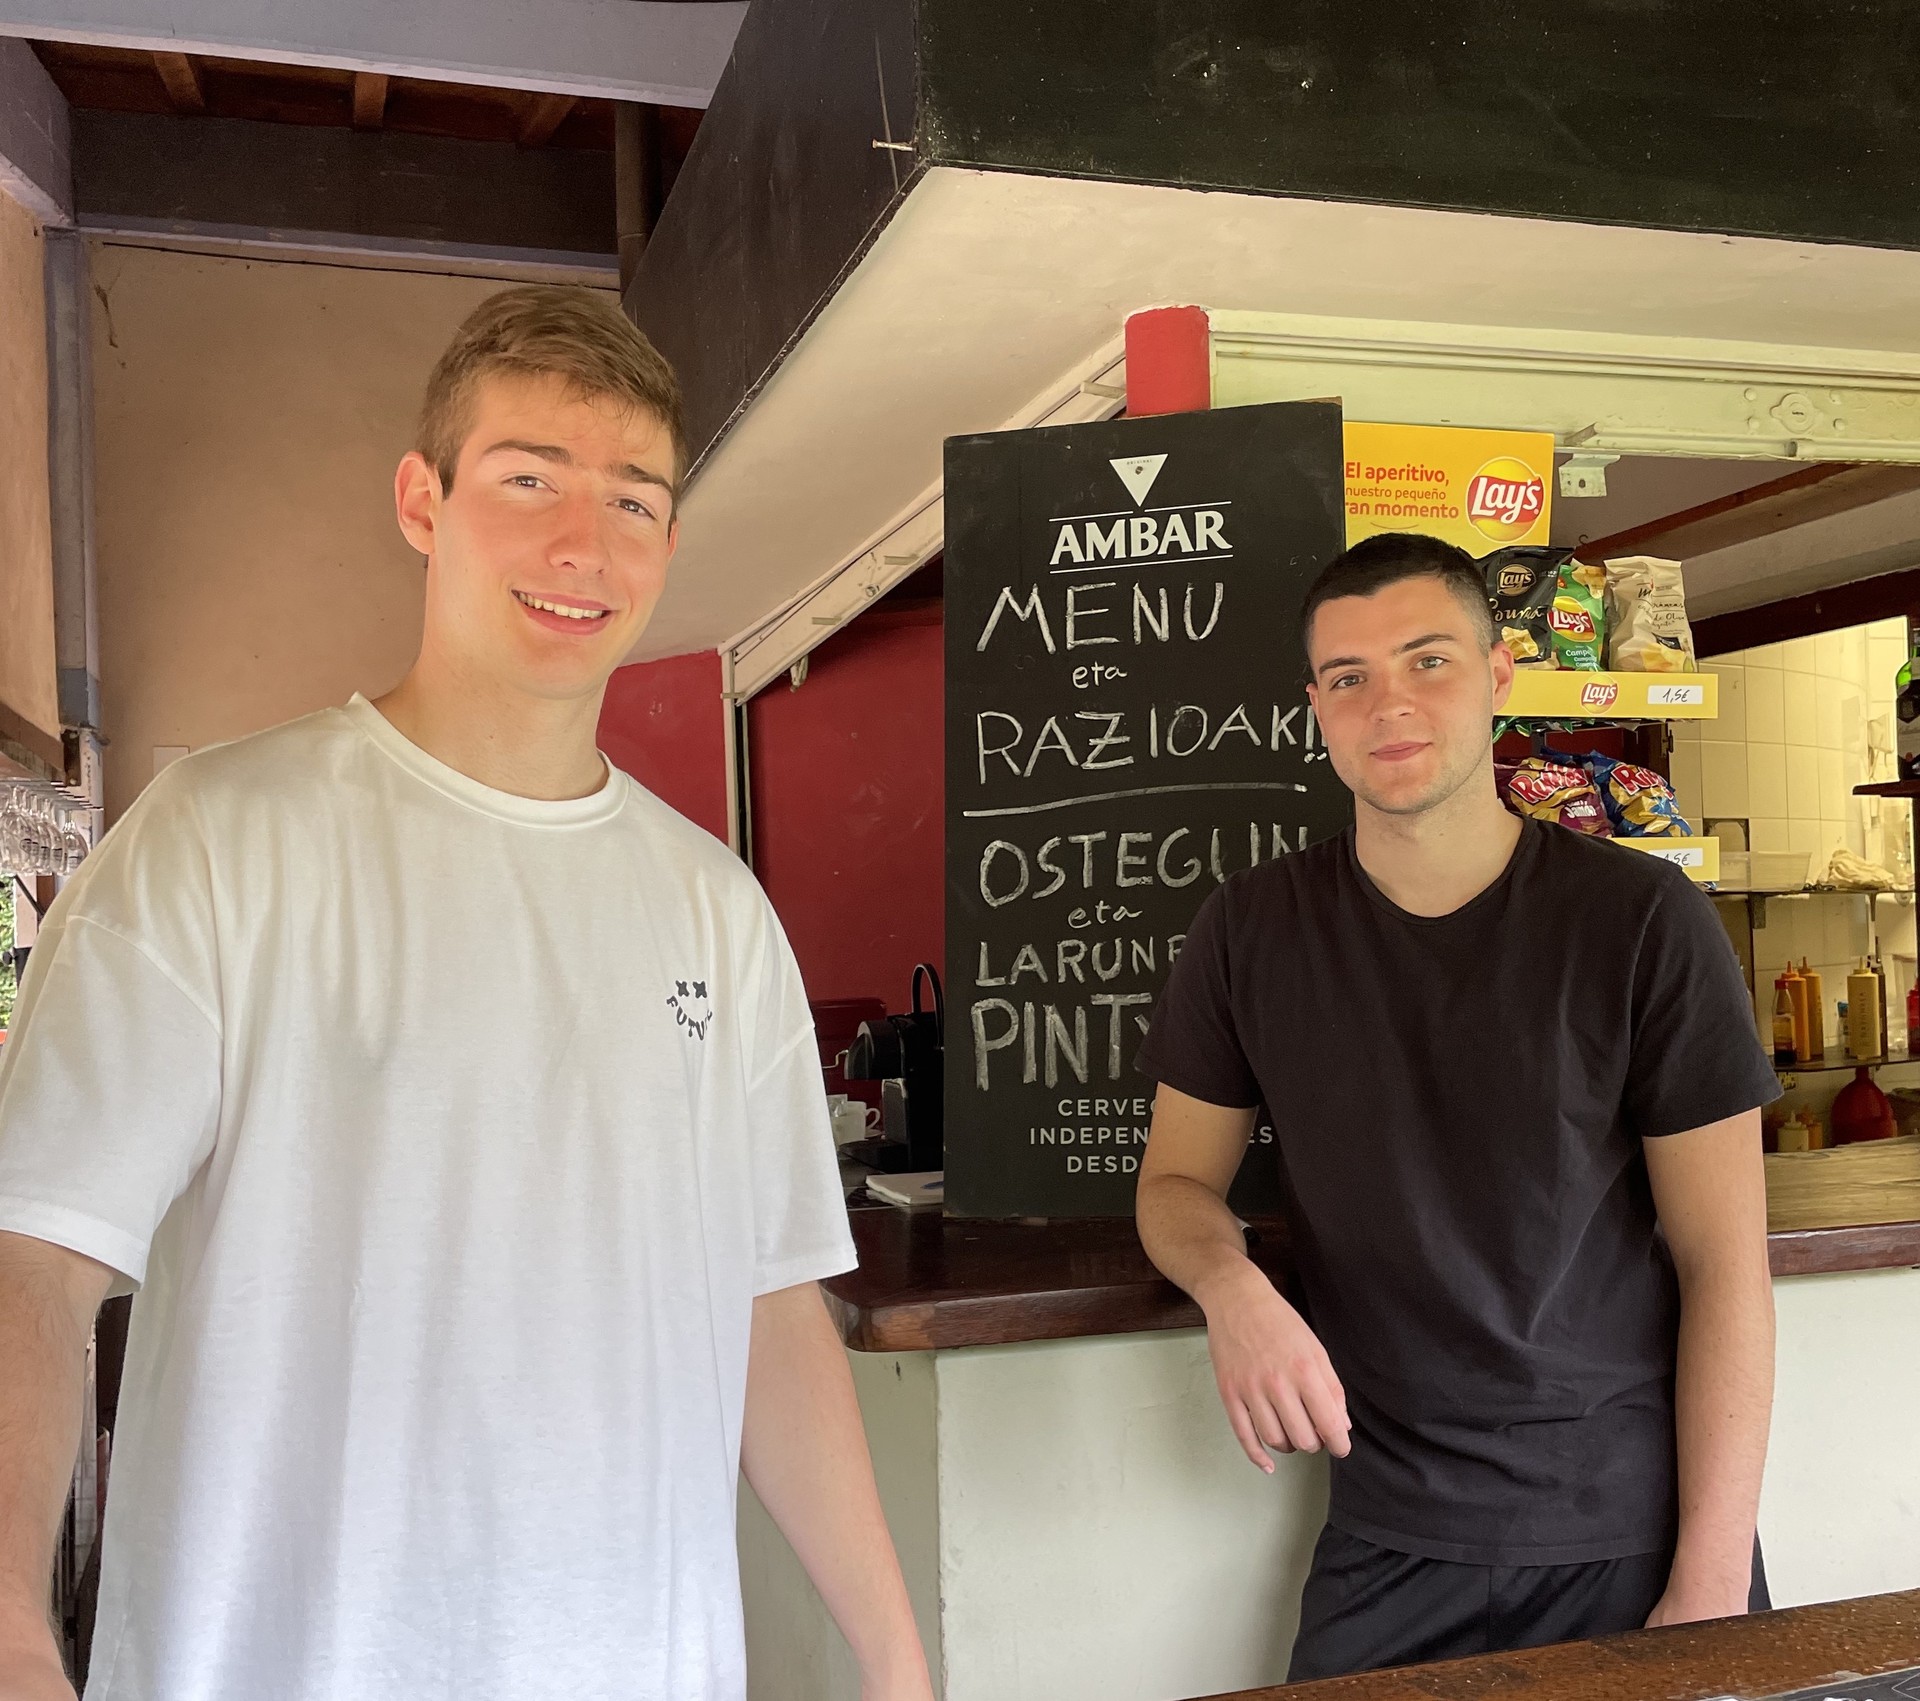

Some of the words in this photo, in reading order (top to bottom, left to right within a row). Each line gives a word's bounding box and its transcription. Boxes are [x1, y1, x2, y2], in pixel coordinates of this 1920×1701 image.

[1345, 462, 1360, 478] El
[1365, 463, 1449, 487] aperitivo,
[1346, 487, 1392, 497] nuestro
[1395, 488, 1446, 502] pequeño
[1471, 477, 1541, 524] Lay's
[1374, 503, 1459, 519] momento
[1049, 510, 1233, 565] AMBAR
[976, 582, 1224, 654] MENU
[1072, 662, 1128, 689] eta
[1582, 683, 1617, 705] Lay's
[1662, 688, 1690, 703] 1,5€
[1067, 901, 1143, 929] eta
[970, 992, 1153, 1091] PINT
[1067, 1155, 1138, 1173] DESD
